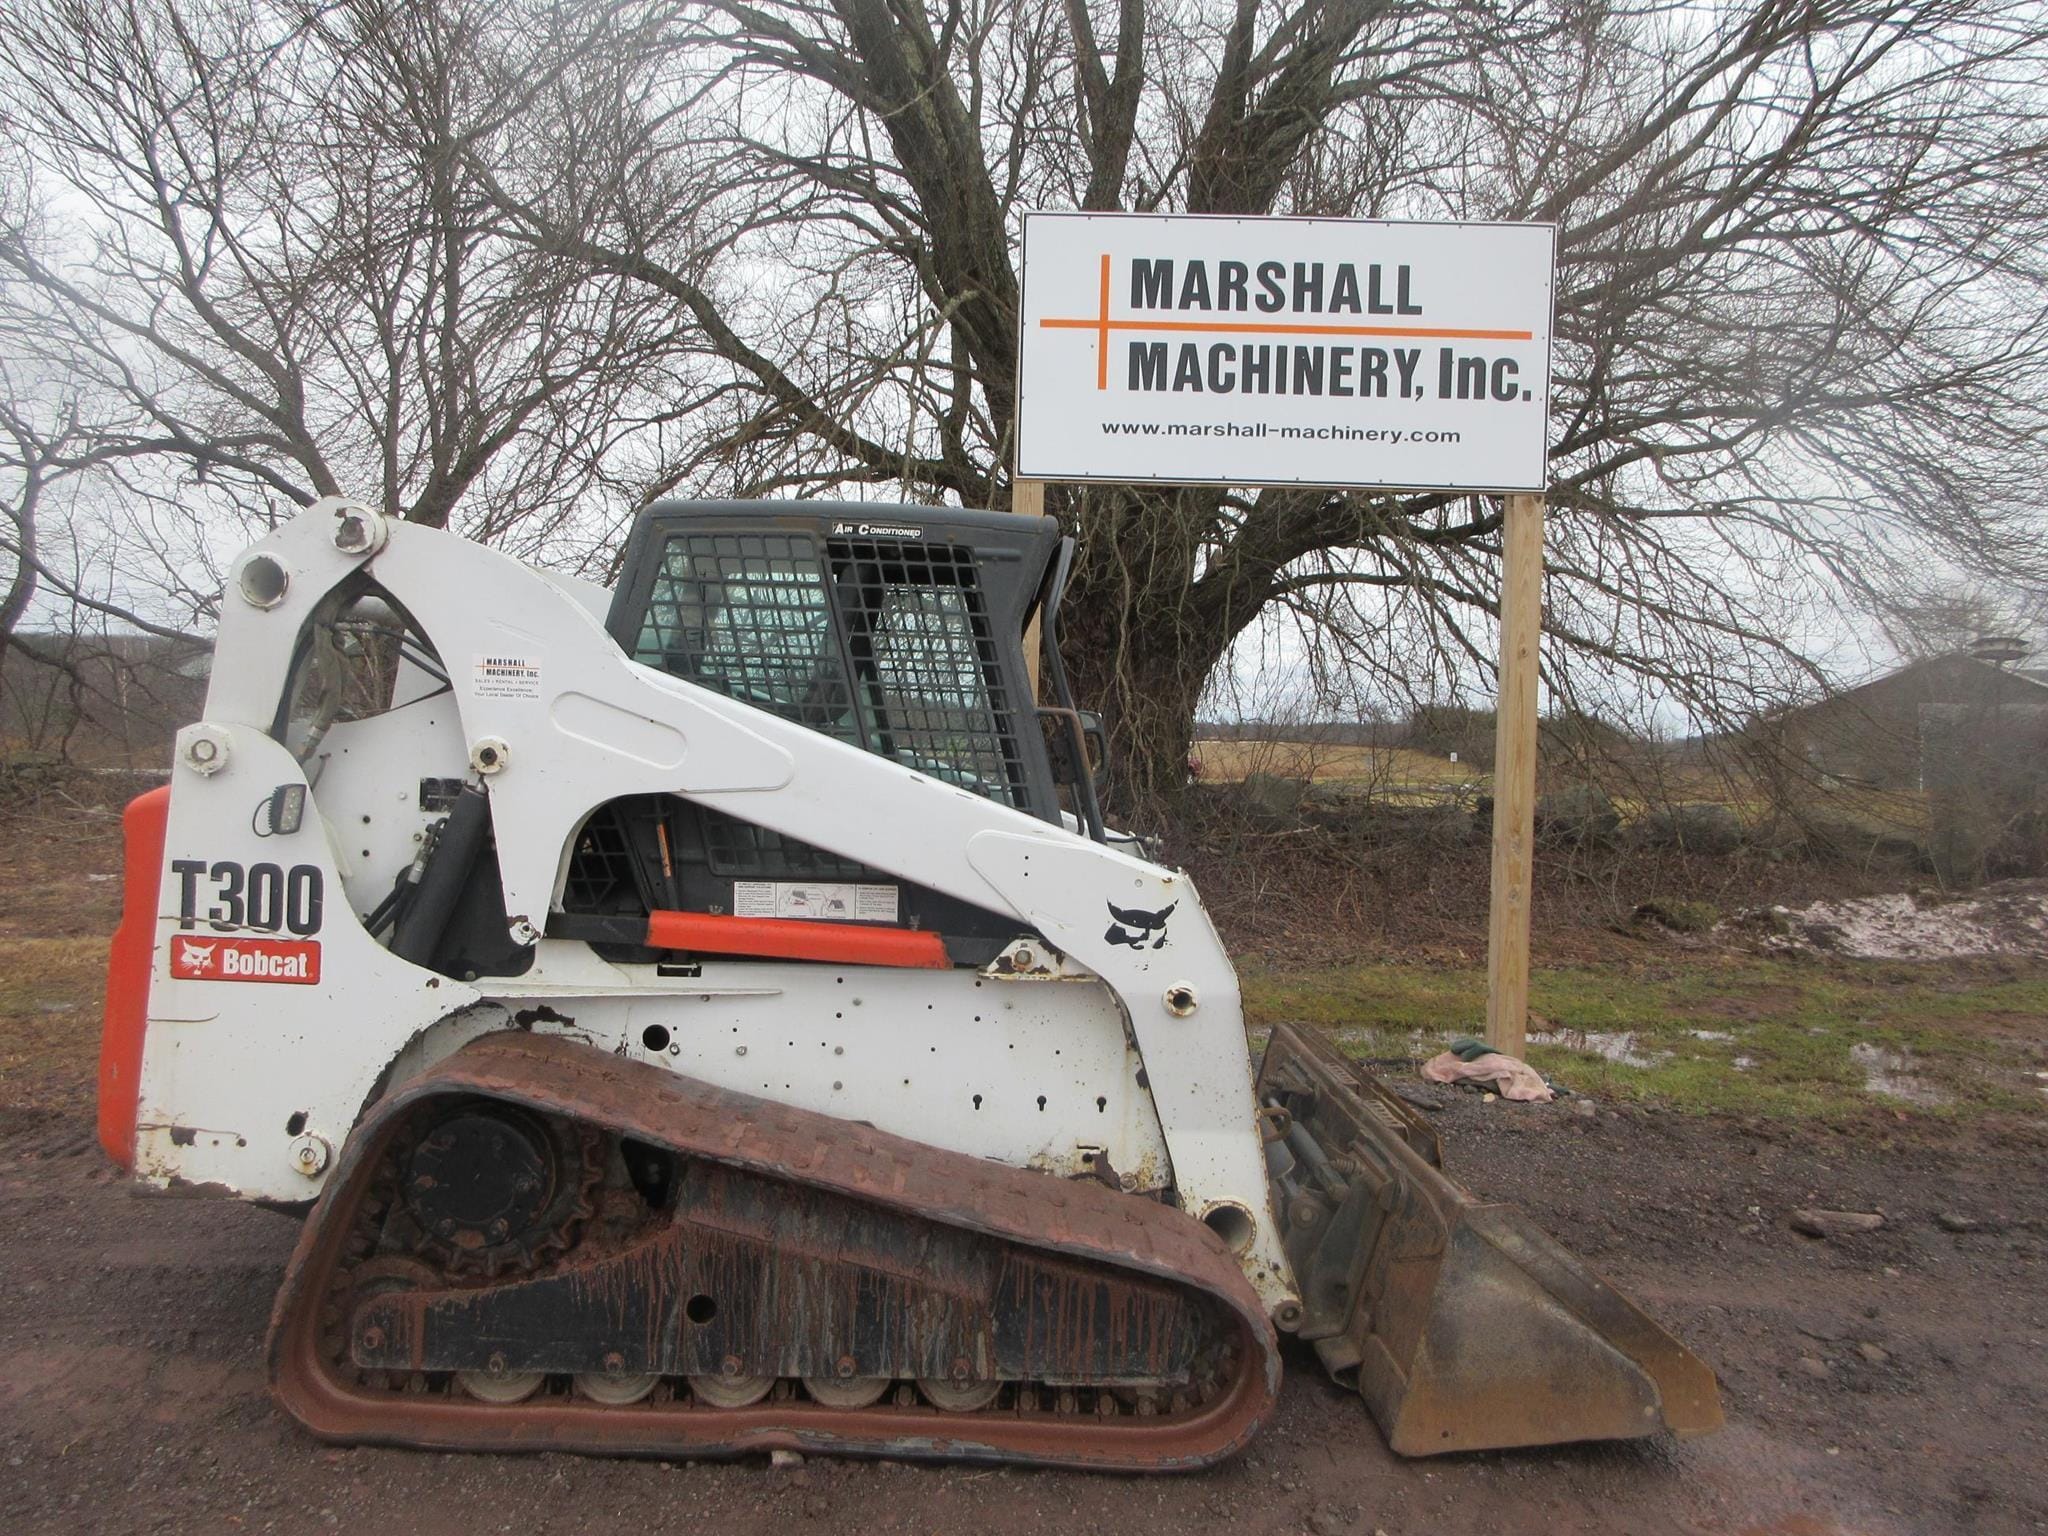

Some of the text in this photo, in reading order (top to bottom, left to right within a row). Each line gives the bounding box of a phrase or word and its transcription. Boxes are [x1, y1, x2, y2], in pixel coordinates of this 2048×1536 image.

[1130, 258, 1423, 315] MARSHALL
[1128, 341, 1533, 402] MACHINERY, Inc.
[1101, 422, 1461, 445] www.marshall-machinery.com
[486, 658, 525, 667] MARSHALL
[172, 860, 324, 935] T300
[223, 948, 308, 977] Bobcat
